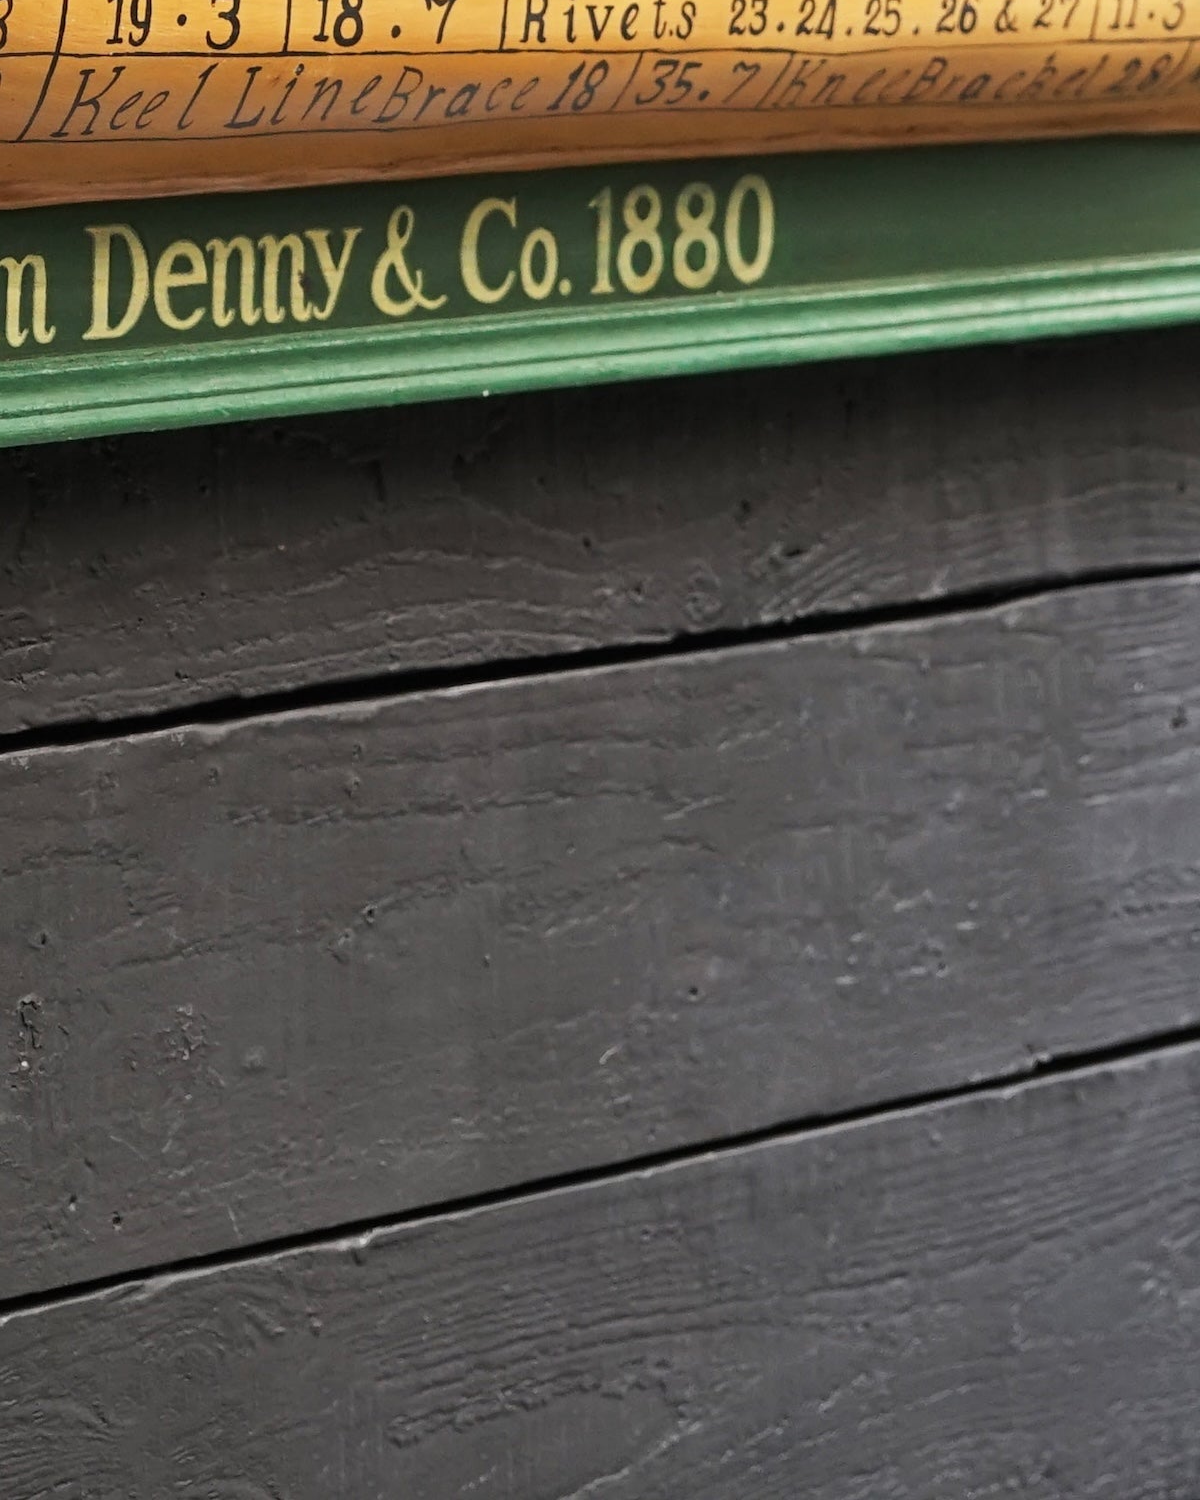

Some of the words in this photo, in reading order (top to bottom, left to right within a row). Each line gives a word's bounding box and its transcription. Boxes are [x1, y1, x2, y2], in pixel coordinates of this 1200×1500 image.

[546, 59, 610, 112] 18
[81, 223, 362, 342] Denny
[370, 204, 447, 319] &
[459, 197, 573, 304] Co.
[586, 174, 775, 296] 1880
